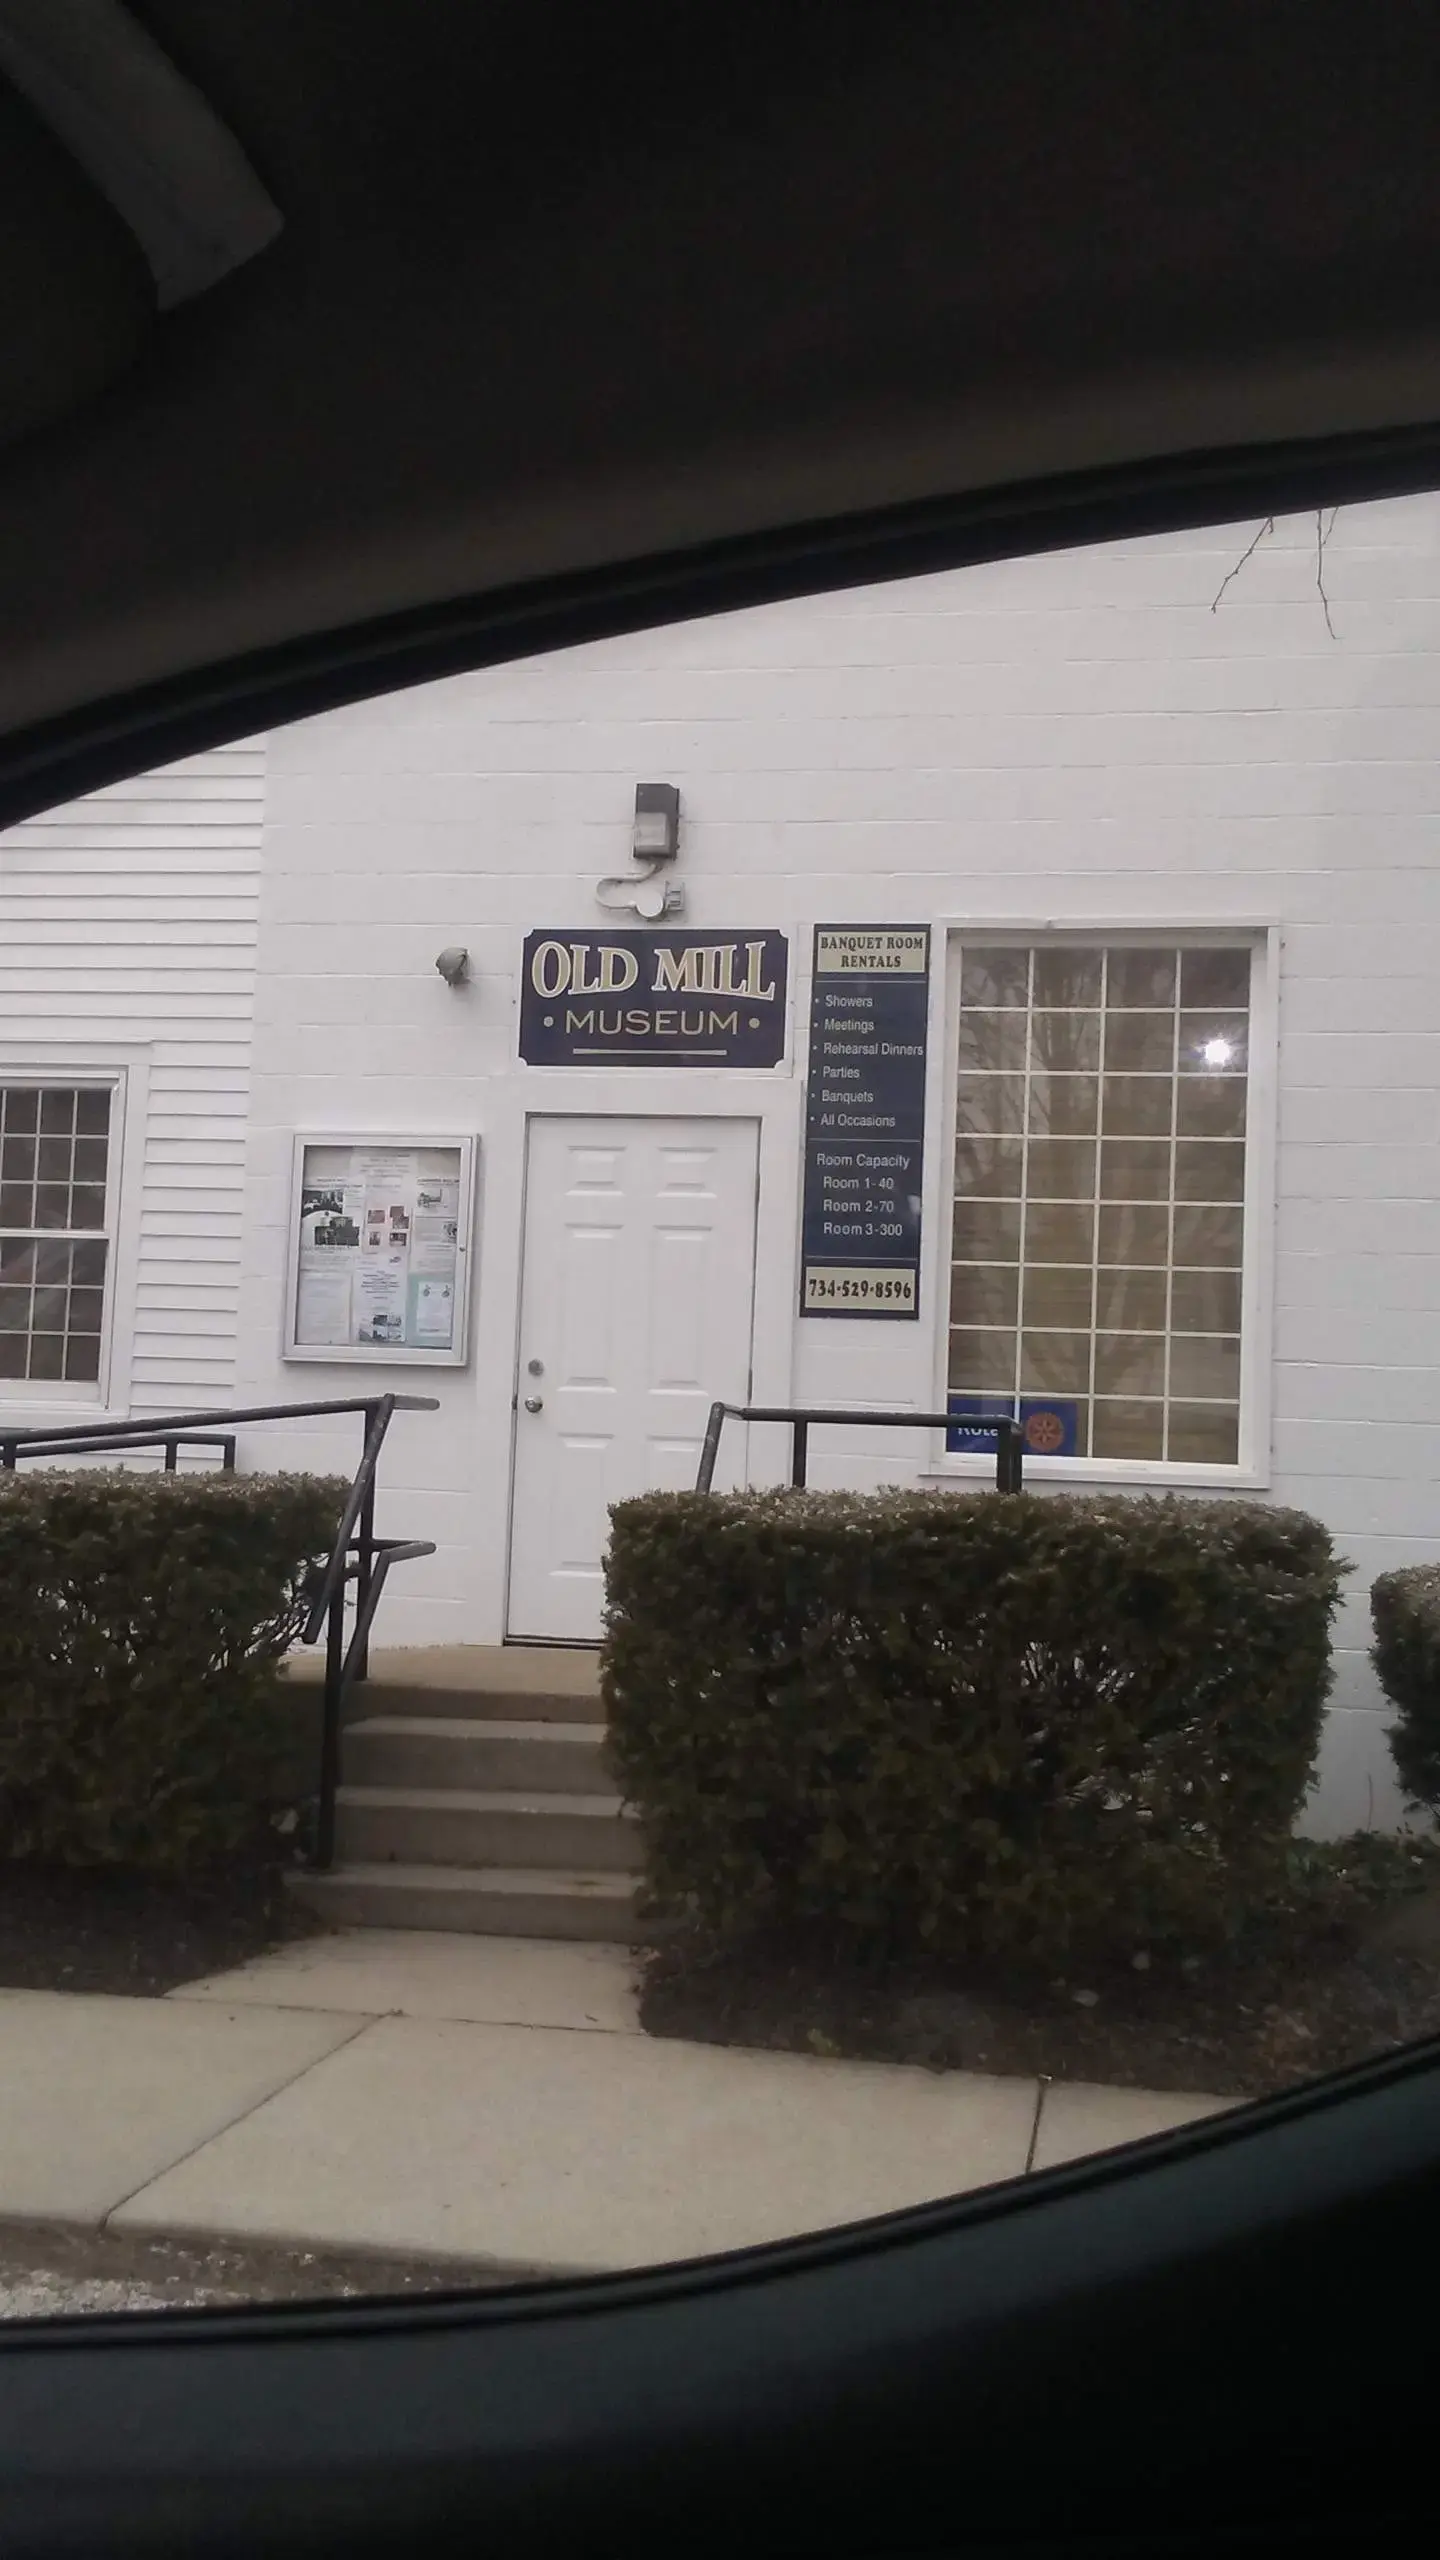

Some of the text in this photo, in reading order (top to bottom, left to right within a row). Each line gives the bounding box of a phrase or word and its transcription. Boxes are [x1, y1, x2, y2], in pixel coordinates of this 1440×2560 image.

[820, 936, 923, 951] BANQUET ROOM
[841, 955, 902, 968] RENTALS
[531, 940, 776, 1001] OLD MILL
[825, 994, 873, 1007] Showers
[565, 1009, 739, 1035] MUSEUM
[824, 1018, 875, 1034] Meetings
[823, 1042, 924, 1056] Rehearsal Dinners
[823, 1065, 860, 1078] Parties
[822, 1089, 874, 1105] Banquets
[820, 1113, 896, 1127] All Occasions
[816, 1153, 911, 1170] Room Capacity
[823, 1176, 860, 1189] Room
[823, 1199, 861, 1212] Room
[823, 1222, 862, 1235] Room
